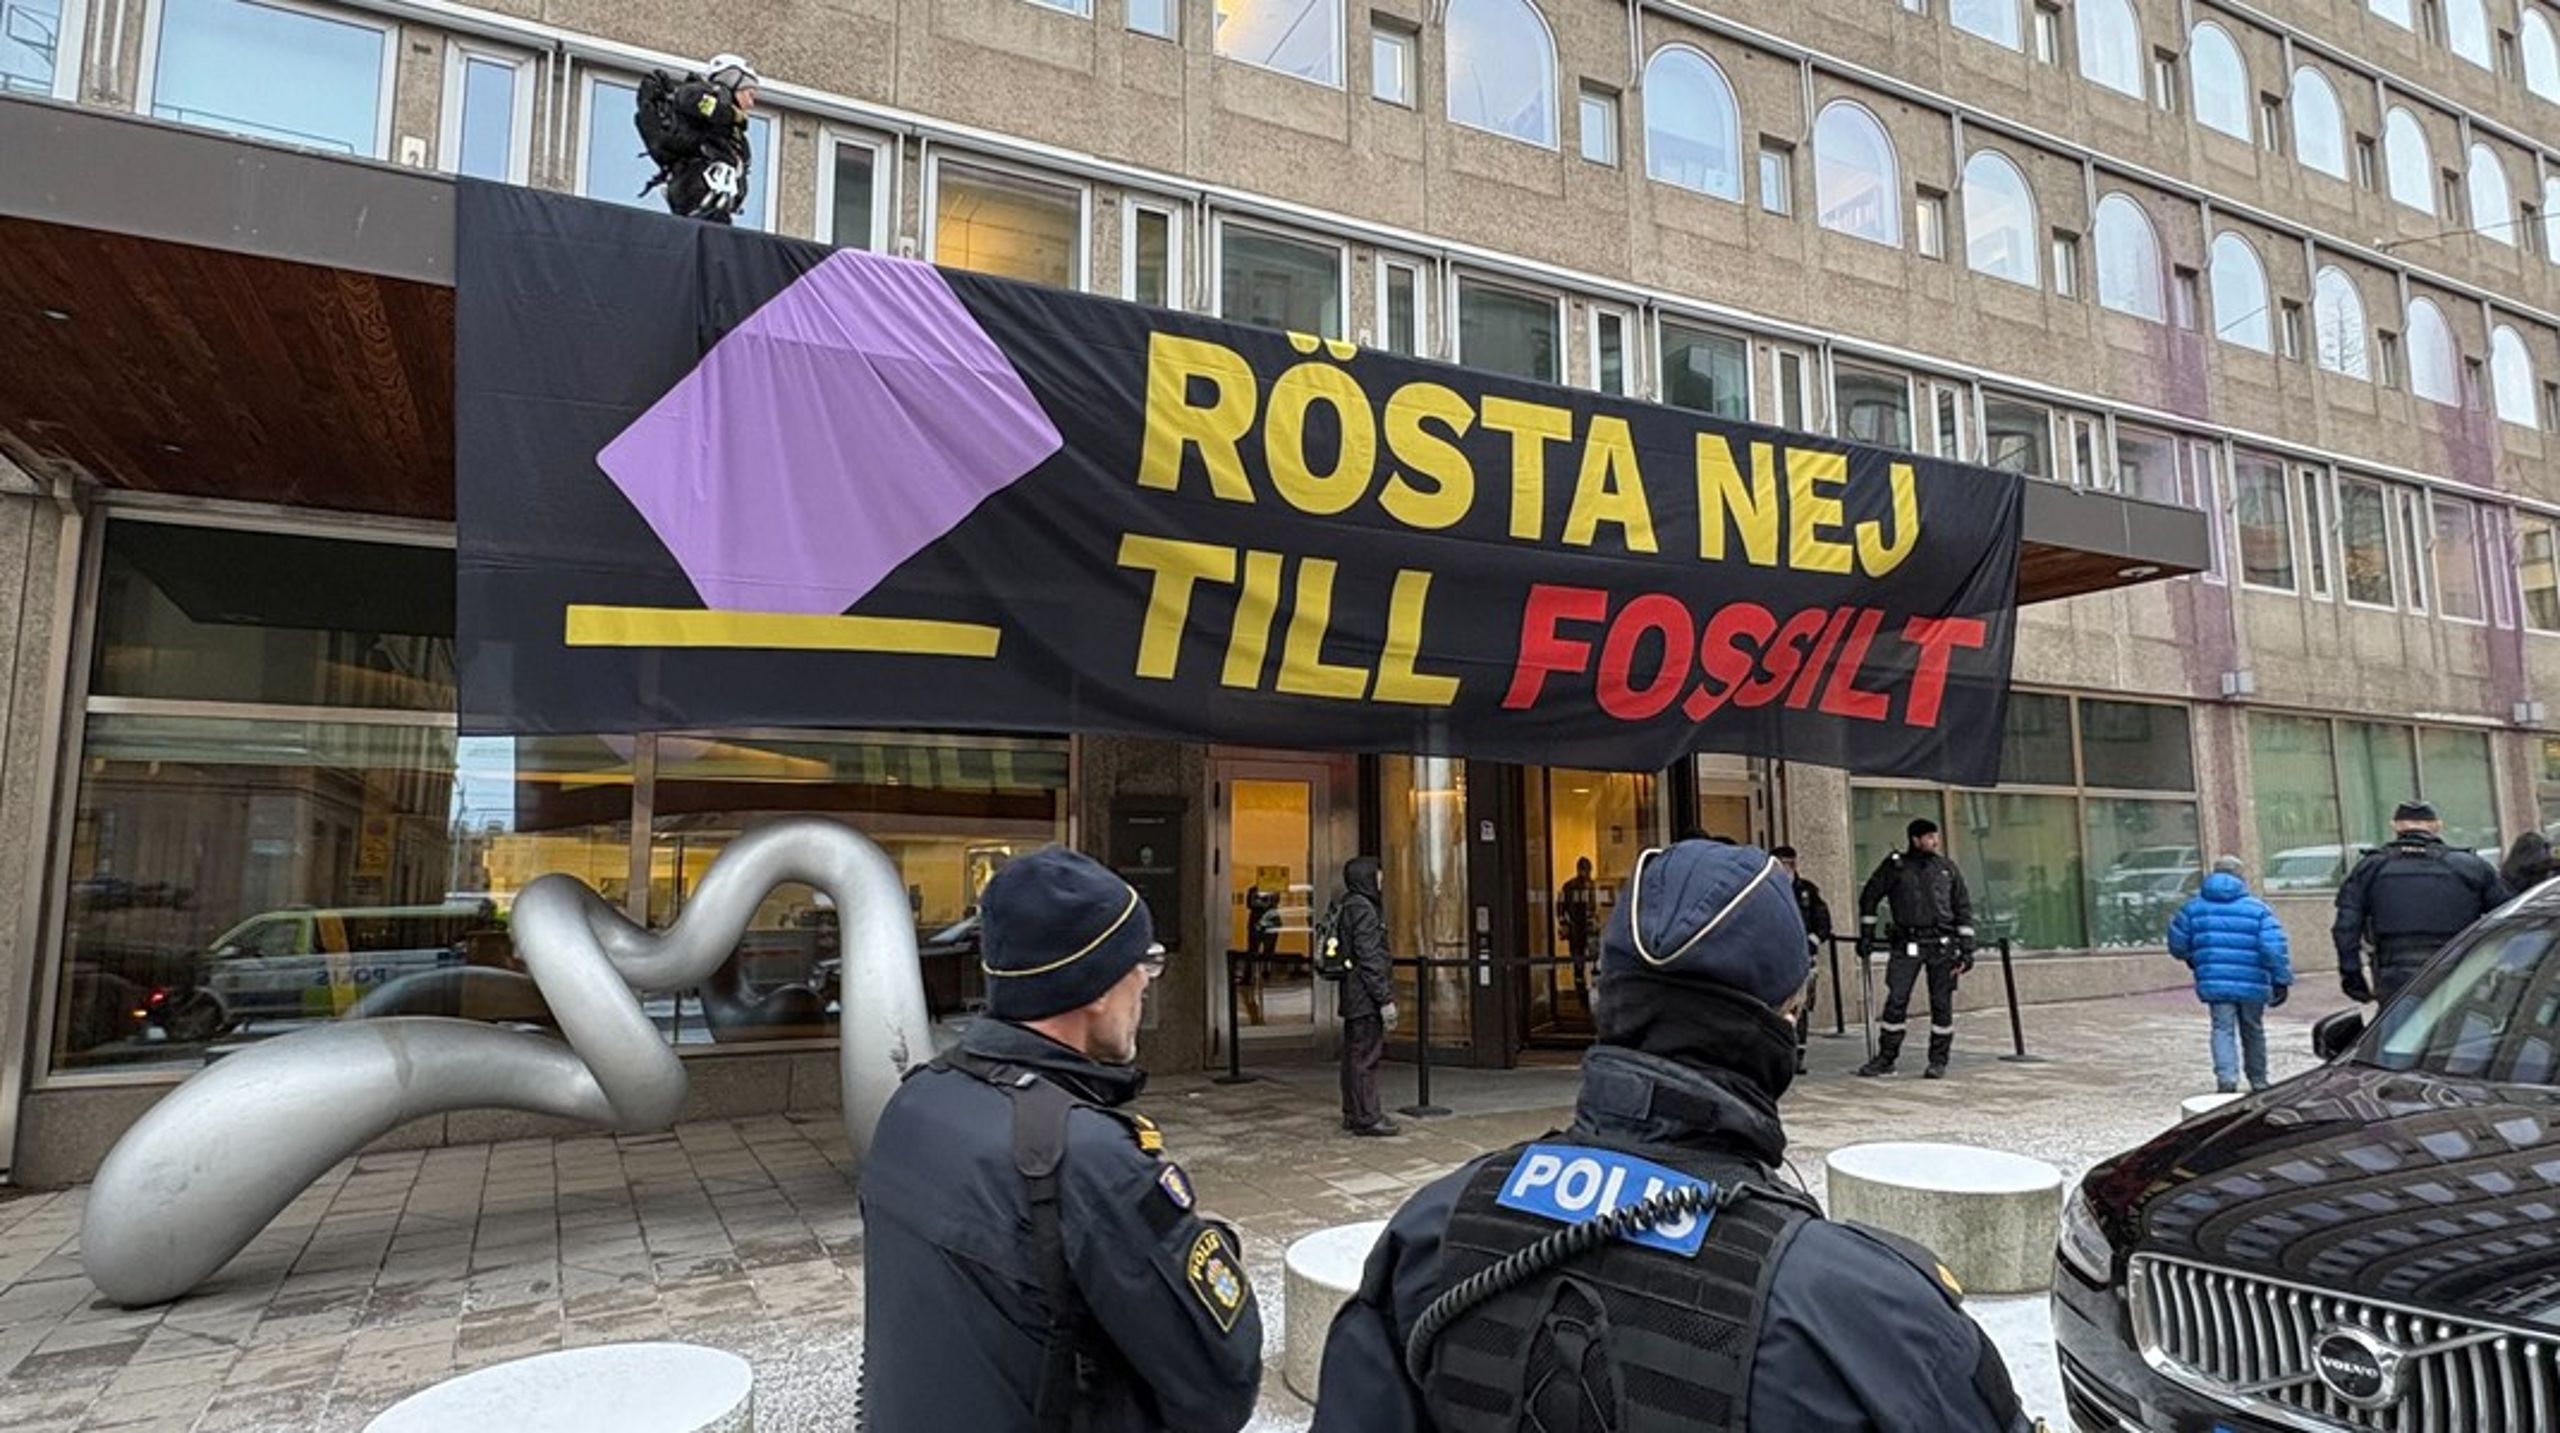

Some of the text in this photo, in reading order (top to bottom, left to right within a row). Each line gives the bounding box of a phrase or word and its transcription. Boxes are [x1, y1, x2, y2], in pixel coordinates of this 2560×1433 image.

[1137, 331, 1921, 579] RÖSTA NEJ
[1117, 533, 1988, 729] TILL FOSSILT
[1191, 1233, 1220, 1281] POLIS
[2320, 1355, 2379, 1379] VOLVO
